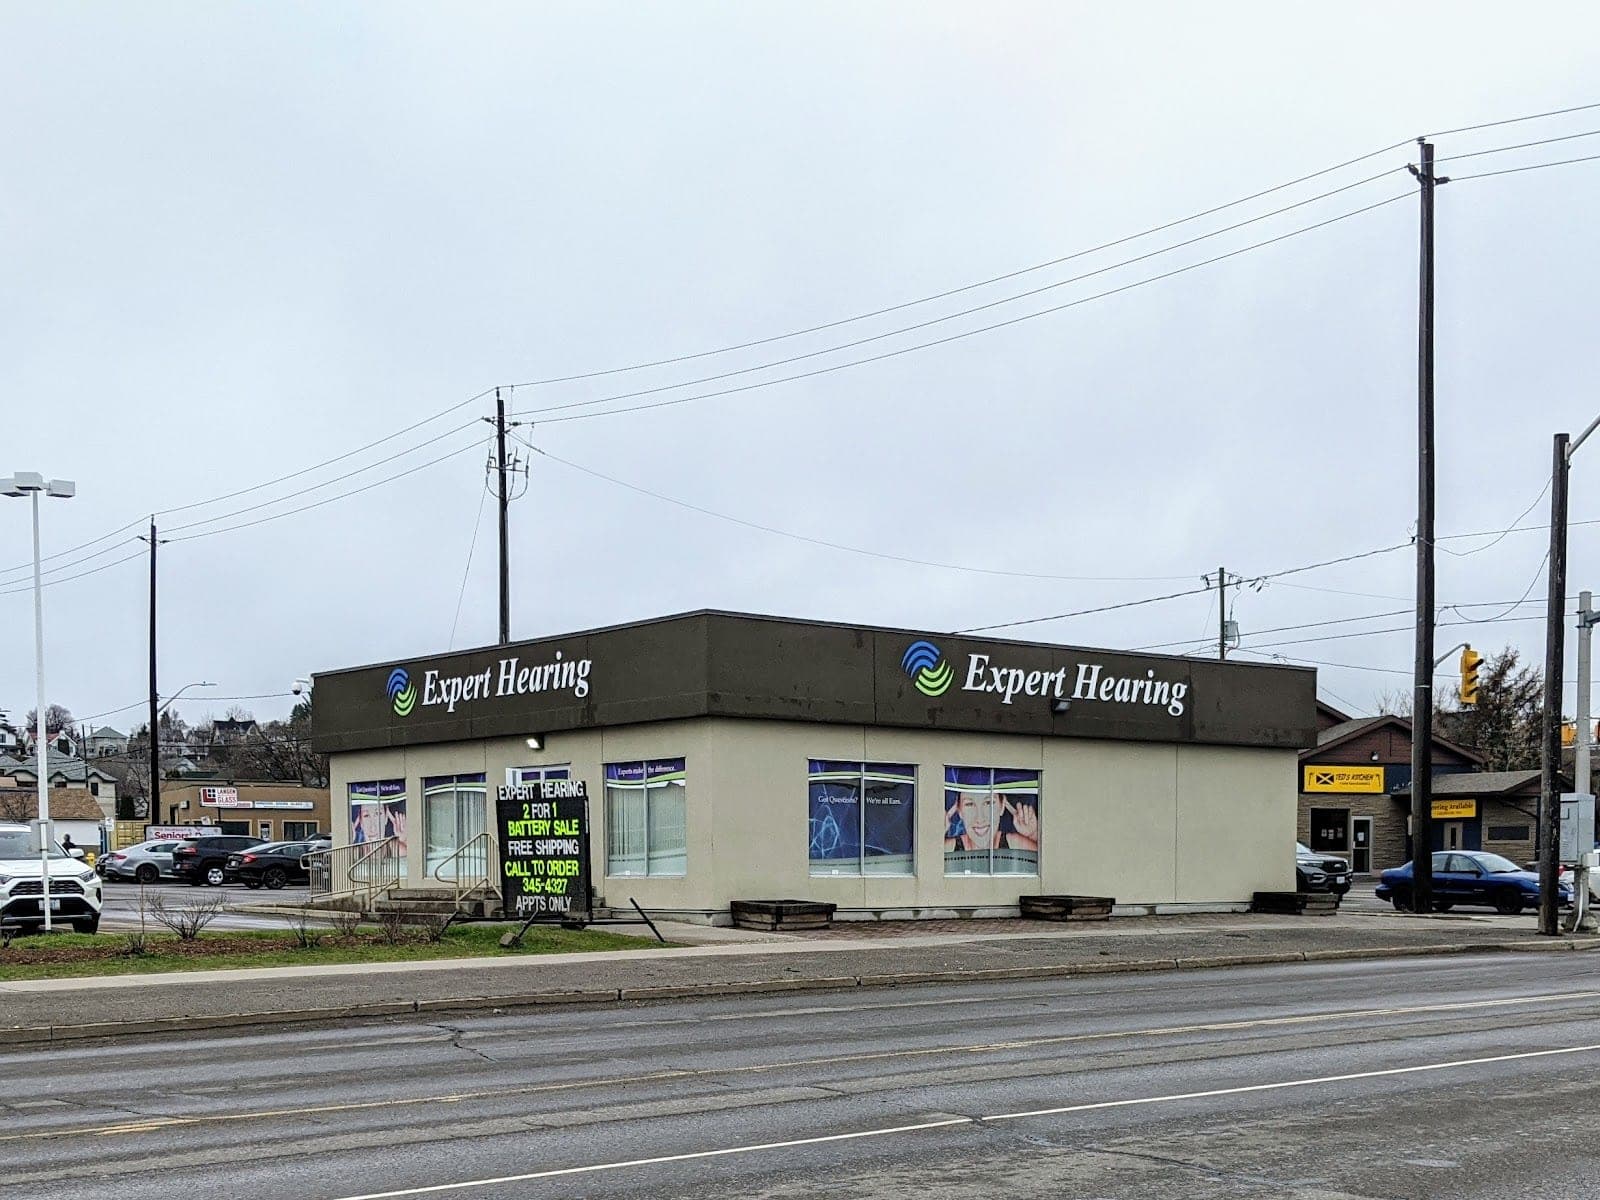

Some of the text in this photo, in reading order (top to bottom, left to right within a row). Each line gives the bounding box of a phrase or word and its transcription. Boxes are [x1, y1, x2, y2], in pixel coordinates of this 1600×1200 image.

[421, 650, 592, 713] Expert Hearing
[961, 653, 1188, 717] Expert Hearing
[498, 780, 584, 801] EXPERT HEARING
[217, 796, 237, 804] GLASS
[866, 796, 881, 805] We're
[523, 801, 557, 819] 2 FOR 1
[508, 819, 580, 837] BATTERY SALE
[508, 838, 580, 856] FREE SHIPPING
[505, 860, 580, 877] CALL TO ORDER
[522, 877, 568, 894] 345-4327
[515, 895, 572, 912] APPTS ONLY
